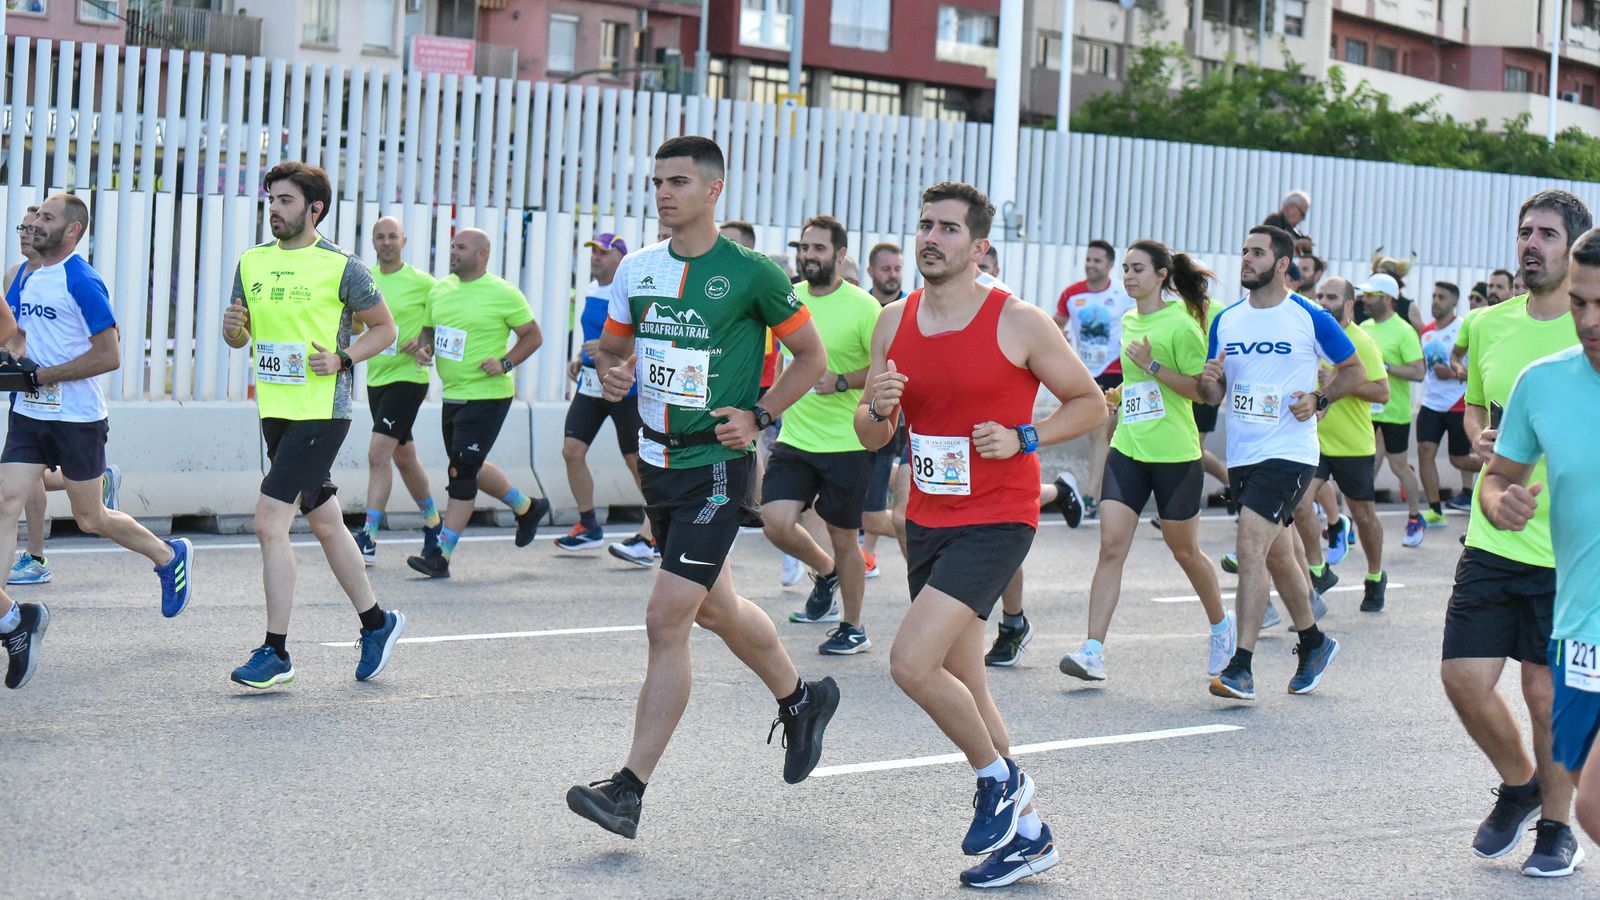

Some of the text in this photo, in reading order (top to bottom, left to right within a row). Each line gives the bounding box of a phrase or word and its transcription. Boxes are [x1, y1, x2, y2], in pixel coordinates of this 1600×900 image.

[21, 303, 57, 320] EVOS
[640, 322, 710, 339] EURAFRICA TRAIL
[1224, 341, 1292, 355] EVOS
[259, 356, 281, 372] 448
[649, 363, 676, 388] 857
[1126, 397, 1141, 414] 587
[1234, 395, 1254, 411] 521
[914, 454, 934, 478] 98
[1572, 641, 1596, 670] 221
